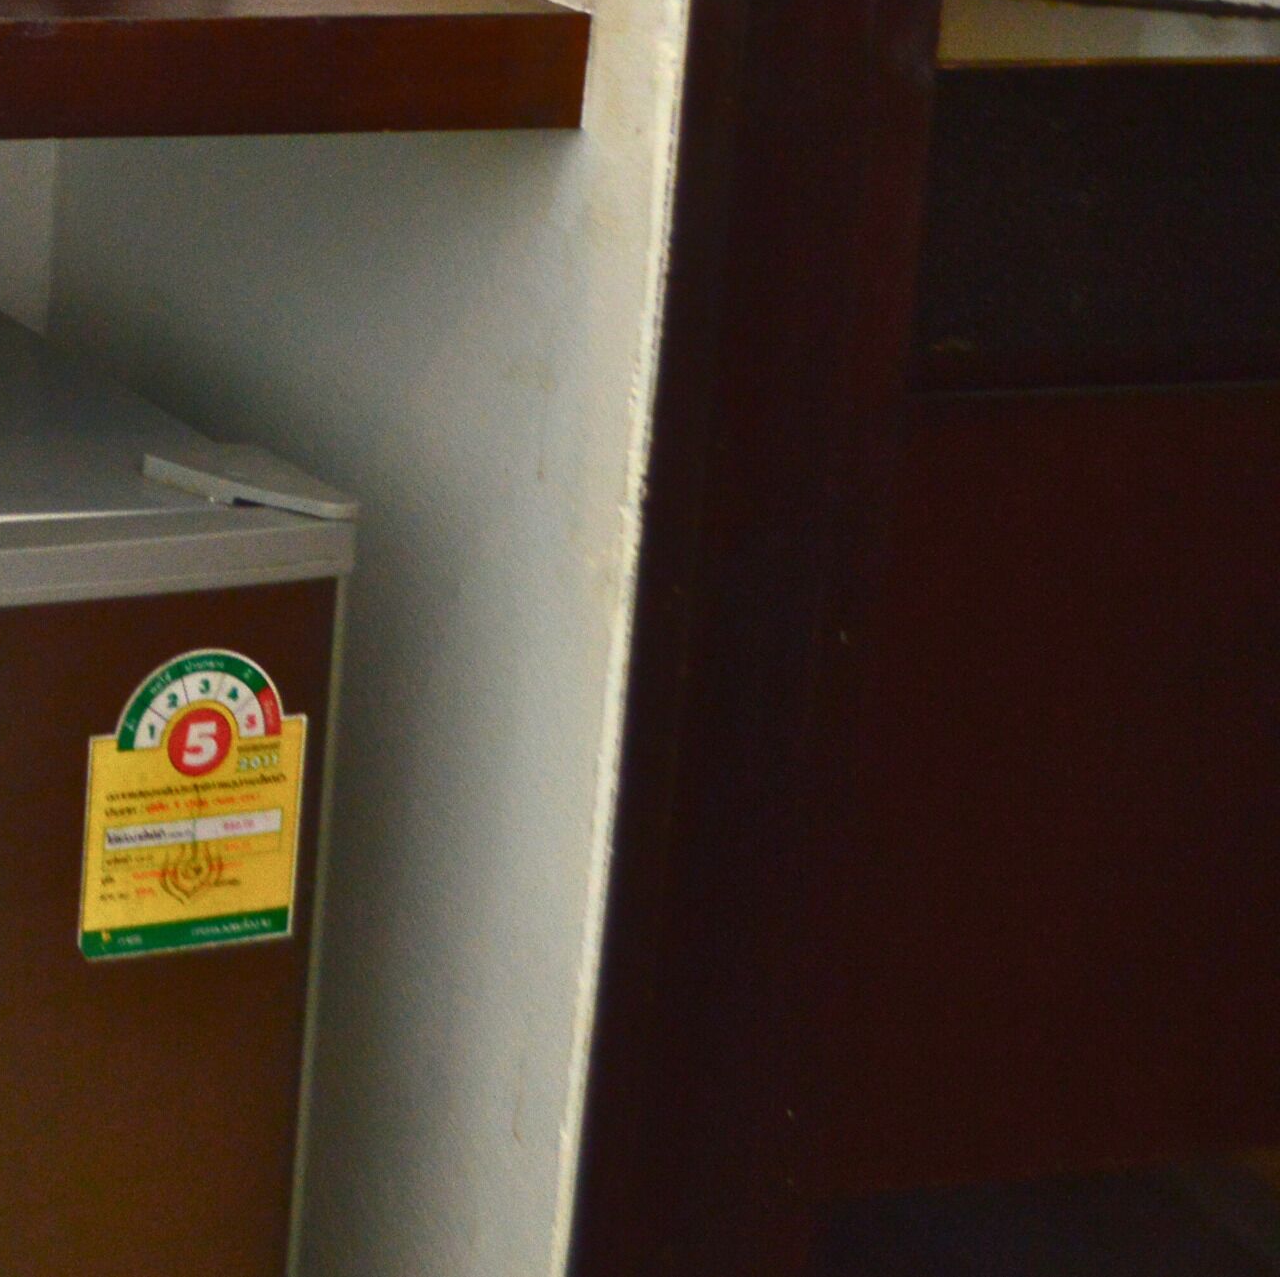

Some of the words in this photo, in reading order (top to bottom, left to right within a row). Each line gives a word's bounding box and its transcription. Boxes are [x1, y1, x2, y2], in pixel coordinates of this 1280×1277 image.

[147, 723, 156, 739] 1
[167, 692, 179, 709] 2
[198, 678, 211, 694] 3
[226, 685, 239, 701] 4
[181, 721, 218, 766] 5
